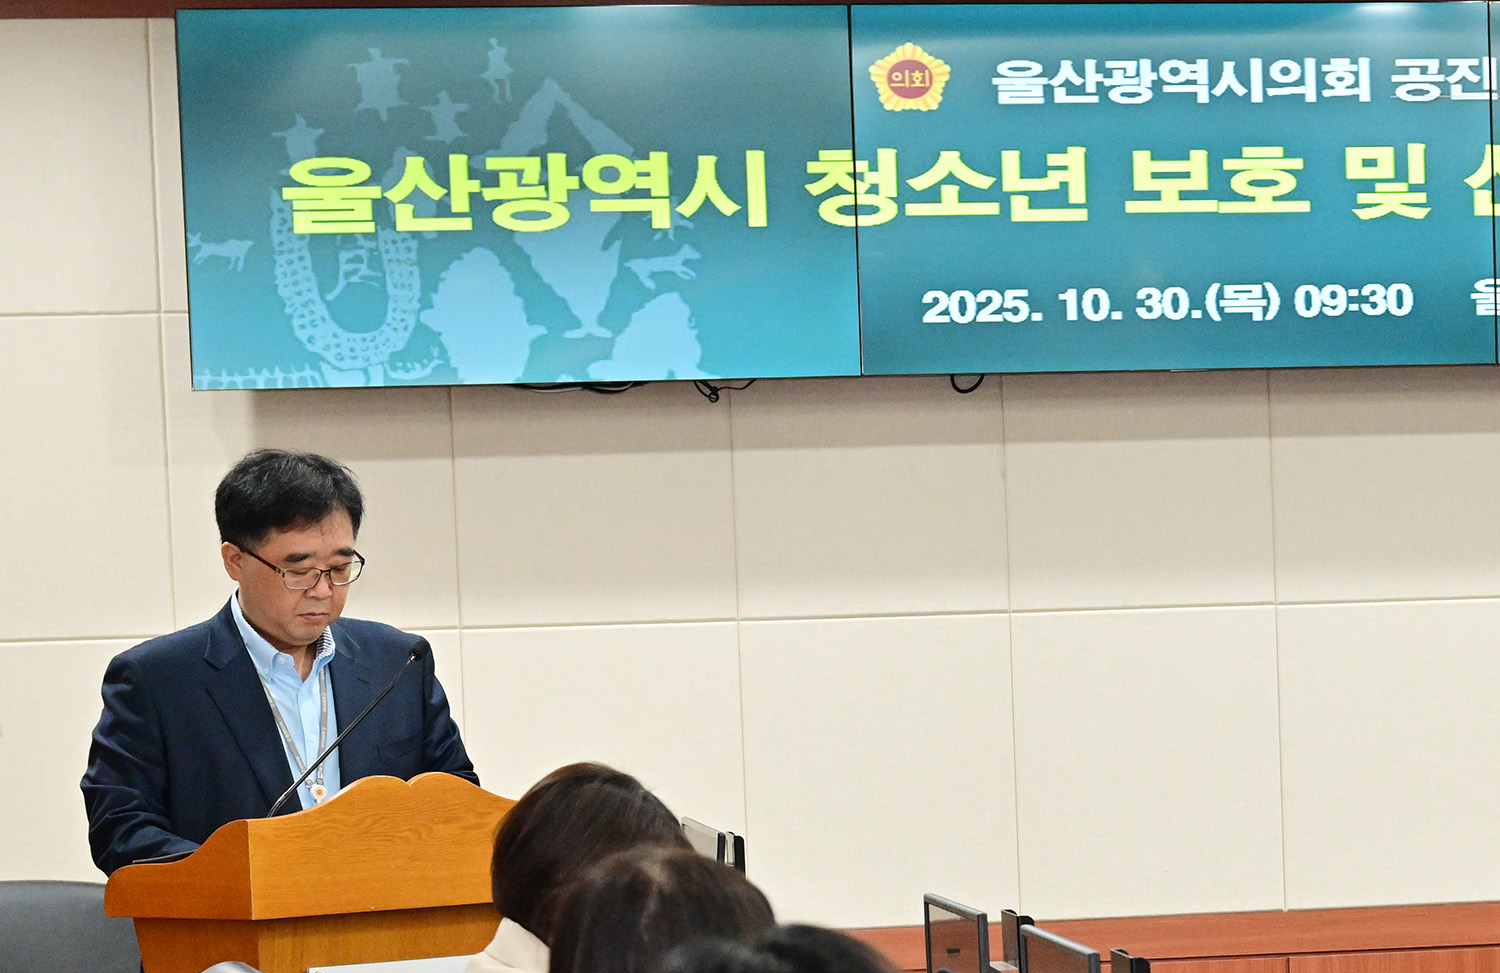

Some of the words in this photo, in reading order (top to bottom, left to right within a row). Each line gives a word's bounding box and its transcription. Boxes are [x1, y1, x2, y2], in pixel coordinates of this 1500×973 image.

[889, 69, 930, 88] 의회
[991, 57, 1371, 104] 울산광역시의회
[281, 149, 768, 234] 울산광역시
[804, 146, 1089, 227] 청소년
[1124, 146, 1311, 214] 보호
[1345, 142, 1432, 220] 및
[922, 289, 1043, 324] 2025.
[1058, 287, 1123, 322] 10.
[1135, 282, 1281, 322] 30.(목)
[1294, 283, 1414, 318] 09:30
